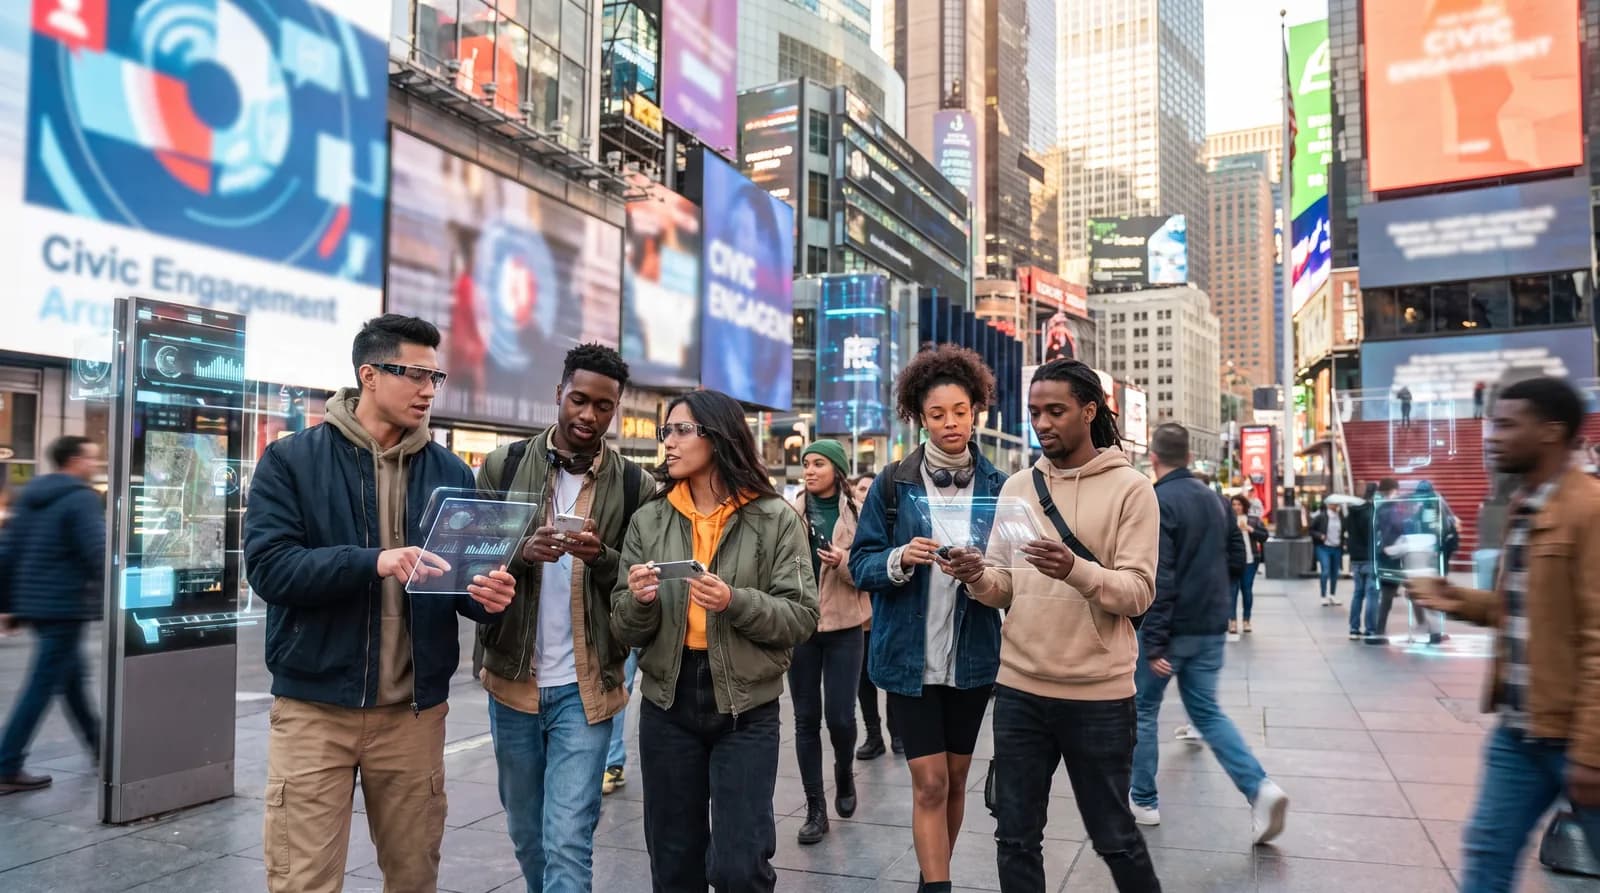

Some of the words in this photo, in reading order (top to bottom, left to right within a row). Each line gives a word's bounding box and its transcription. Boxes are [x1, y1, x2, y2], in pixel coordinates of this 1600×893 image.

[41, 234, 139, 284] Civic
[152, 256, 338, 324] Engagement
[708, 239, 756, 290] CIVIC
